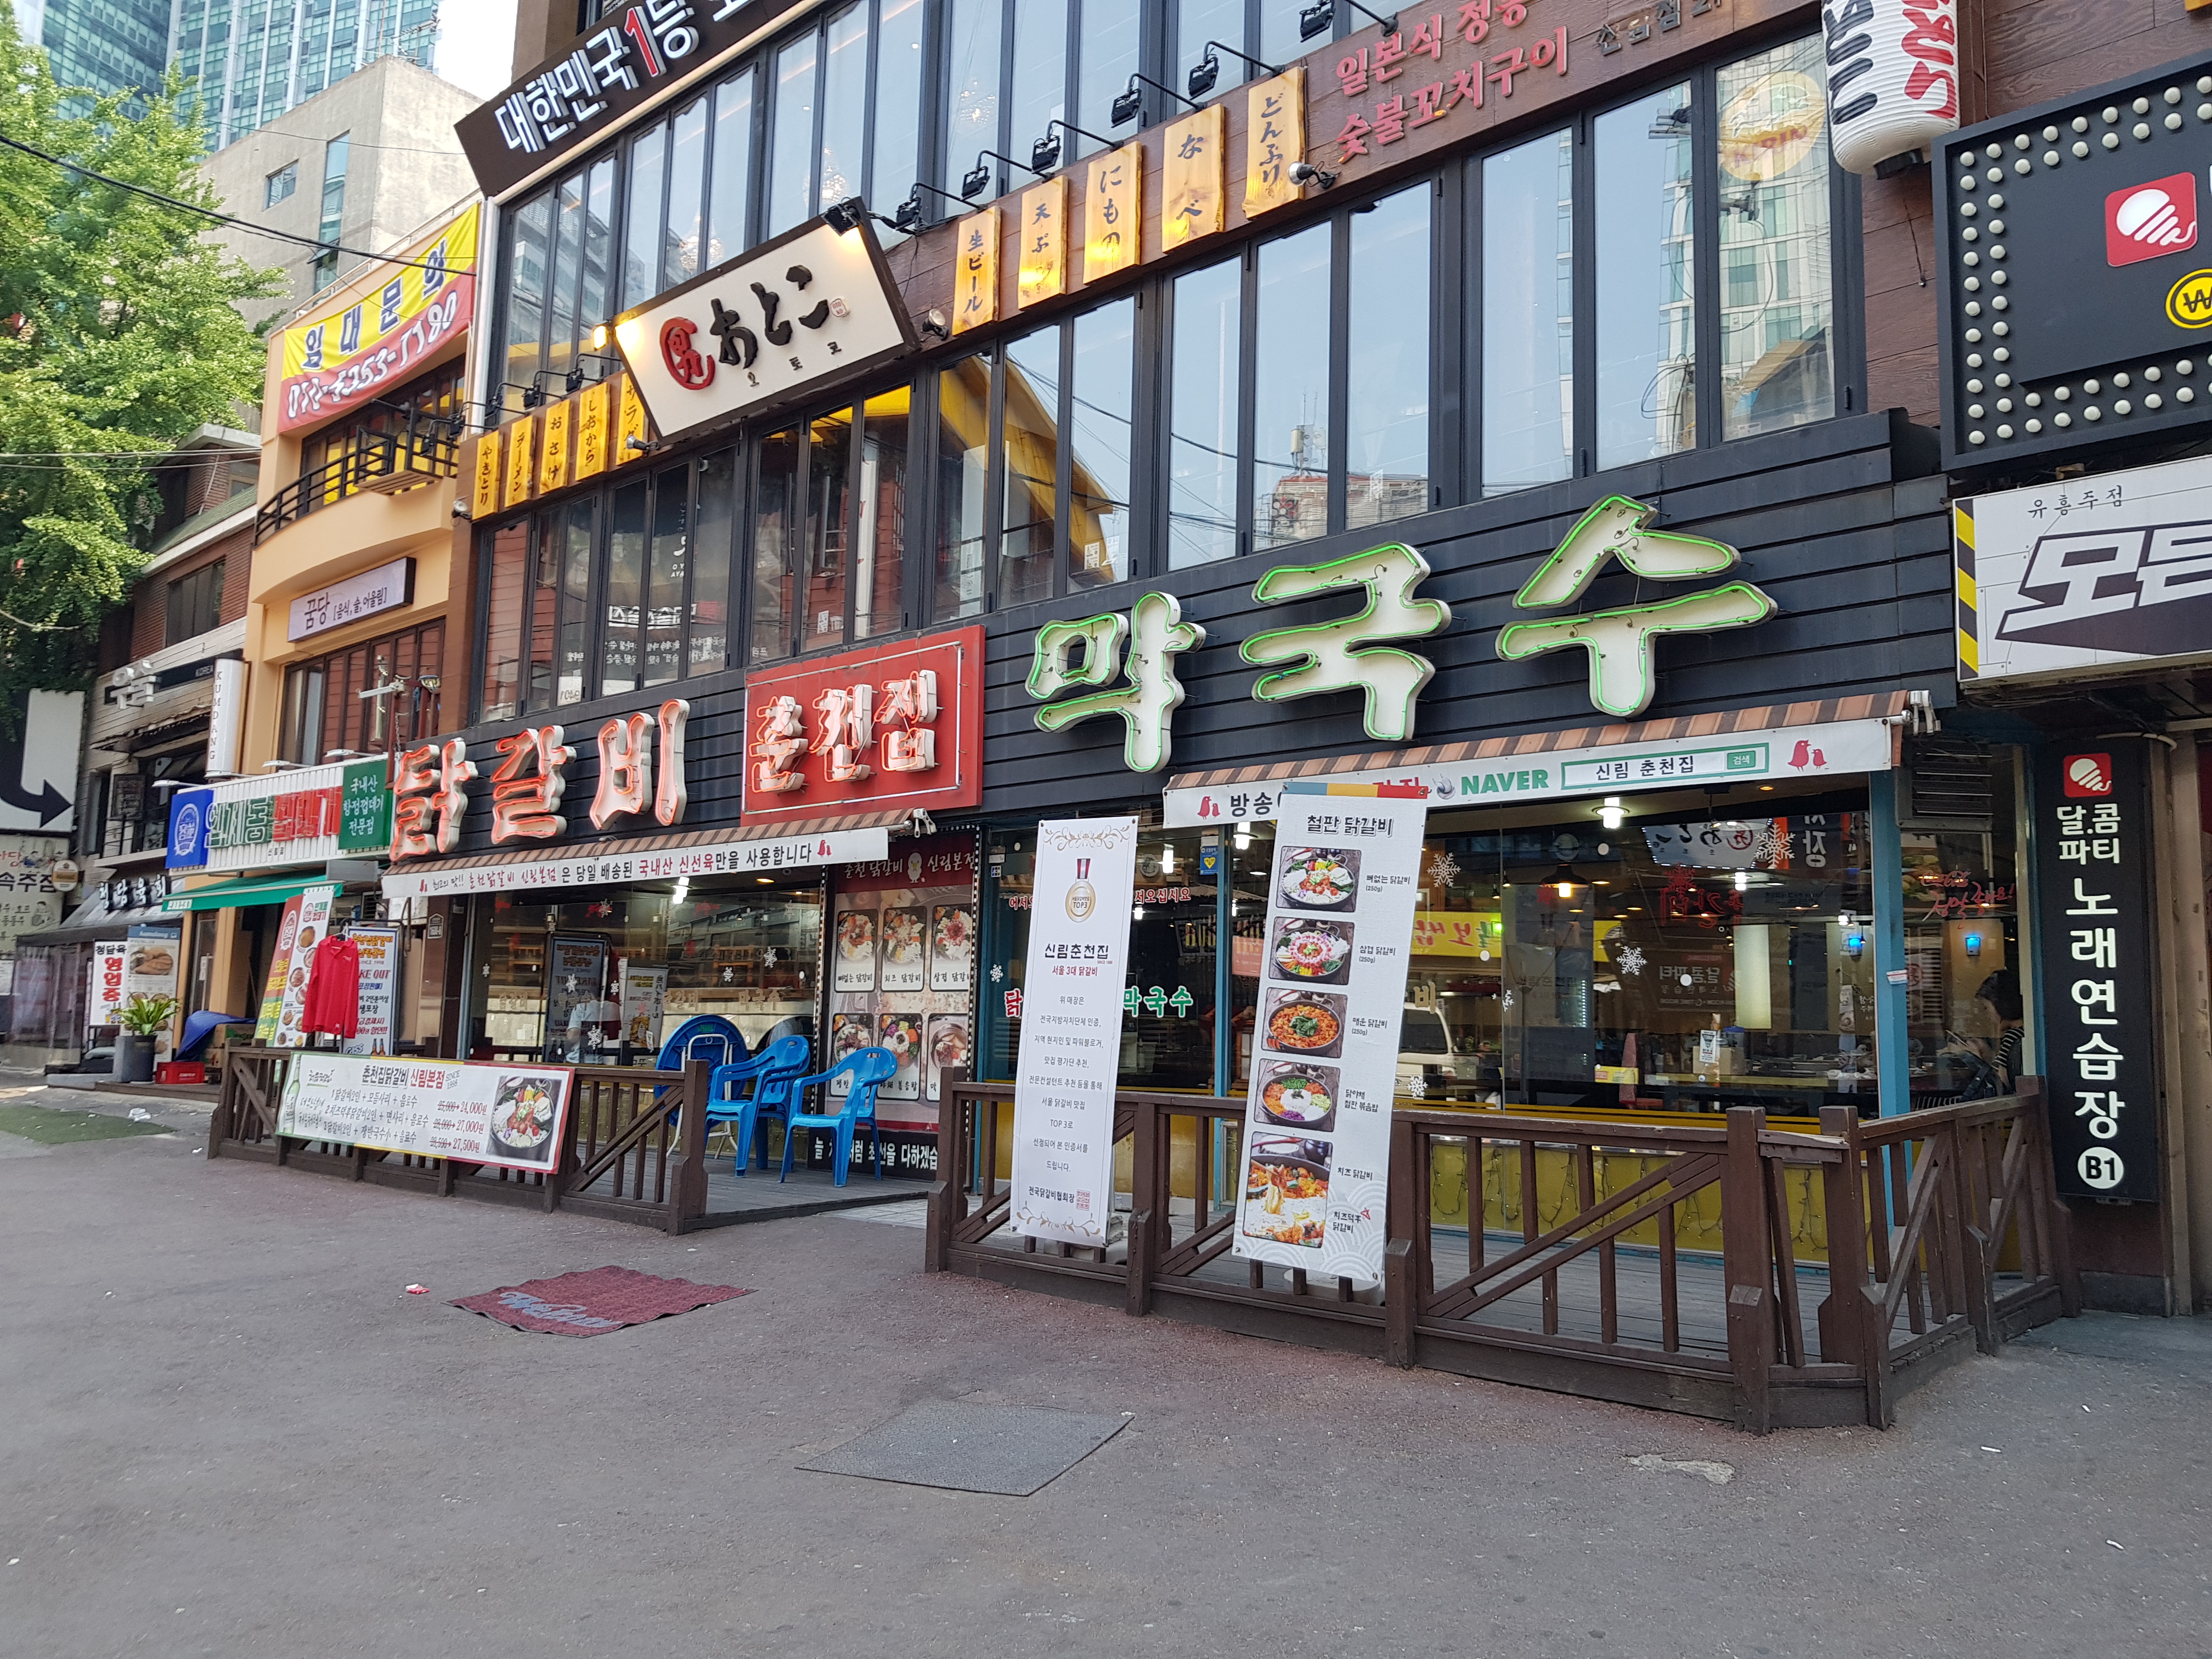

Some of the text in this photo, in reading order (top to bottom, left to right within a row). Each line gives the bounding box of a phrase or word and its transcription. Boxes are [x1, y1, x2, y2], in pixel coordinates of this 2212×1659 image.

[1336, 14, 1443, 97] 일본식
[1336, 26, 1567, 163] 숯불꼬치구이
[1260, 92, 1284, 185] どんぶり
[1176, 133, 1206, 221] なべ
[1099, 165, 1122, 255] にもの
[963, 229, 984, 313] 生ビール
[301, 236, 447, 370] 임대문의
[548, 416, 561, 483] おさけ
[479, 446, 492, 505] やきとり
[2027, 484, 2122, 518] 유흥주점
[390, 494, 1778, 862] 닭갈비 춘천집 막국수
[1595, 753, 1750, 781] 신림 춘천집 검색
[350, 775, 378, 795] 국내산
[1461, 769, 1548, 795] NAVER
[1230, 792, 1282, 817] 방송
[348, 816, 374, 836] 전문점
[1307, 815, 1393, 836] 철판 닭갈비
[577, 865, 596, 882] 당일
[601, 860, 633, 881] 배송된
[639, 854, 673, 877] 국내산
[747, 843, 812, 866] 사용합니다
[870, 859, 903, 877] 닭갈비
[928, 851, 975, 872] 신림본점
[2059, 839, 2119, 864] 파티
[1390, 875, 1410, 885] 닭갈비
[1133, 888, 1191, 904] 서오십시요
[1045, 943, 1109, 959] 신림춘천집
[1359, 946, 1396, 956] 삼겹 닭갈비
[103, 957, 123, 1001] 영업중
[373, 969, 391, 978] OUT
[885, 974, 921, 982] 치즈 닭갈비
[1052, 965, 1097, 977] 서울 3대 닭갈비
[1124, 986, 1193, 1017] 막국수
[2066, 877, 2124, 1139] 노래연습장
[1368, 1018, 1387, 1029] 닭갈비
[362, 1065, 409, 1087] 춘천집닭갈비
[410, 1069, 445, 1088] 신림본점
[1054, 1098, 1072, 1108] 닭갈비
[1344, 1099, 1378, 1113] 철판 볶음밥
[1050, 1119, 1062, 1127] TOP
[1338, 1166, 1373, 1181] 치즈 닭갈비
[2084, 1156, 2116, 1180] B1
[1332, 1222, 1353, 1233] 닭갈비
